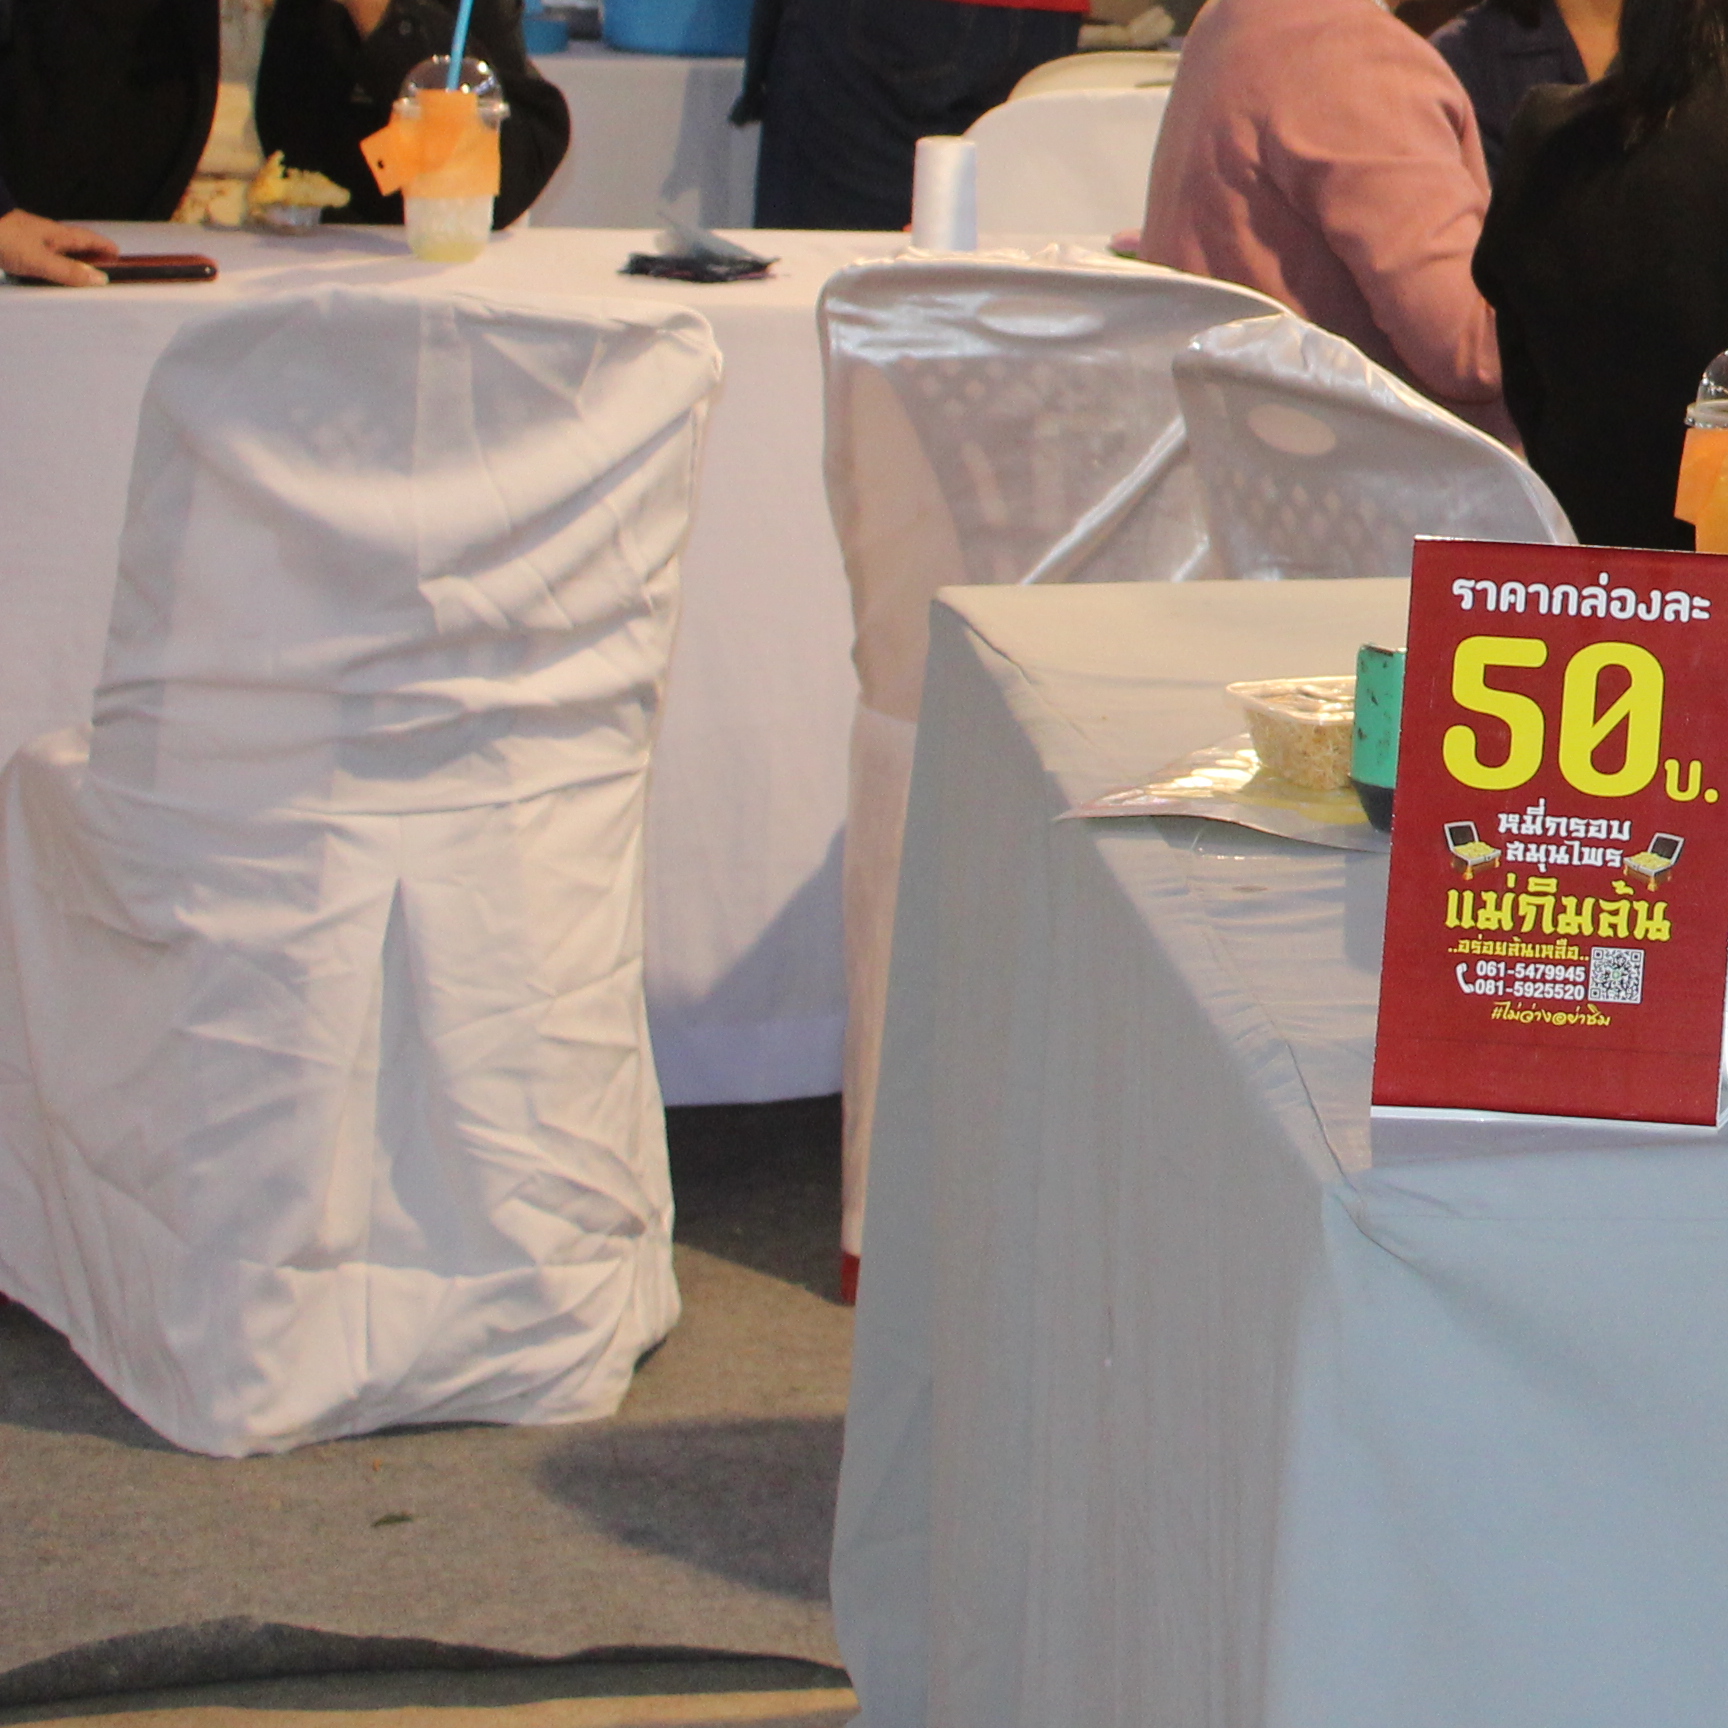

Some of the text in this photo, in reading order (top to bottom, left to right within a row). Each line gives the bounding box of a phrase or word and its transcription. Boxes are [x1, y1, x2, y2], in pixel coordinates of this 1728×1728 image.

[1452, 572, 1711, 623] ราคากล่องละ
[1497, 797, 1632, 841] หมี่กรอบ
[1506, 839, 1623, 873] สมุนไพร
[1445, 872, 1672, 942] แม่กิมล้น
[1475, 979, 1586, 1001] 081-5925520
[1476, 960, 1586, 982] 061-5479945
